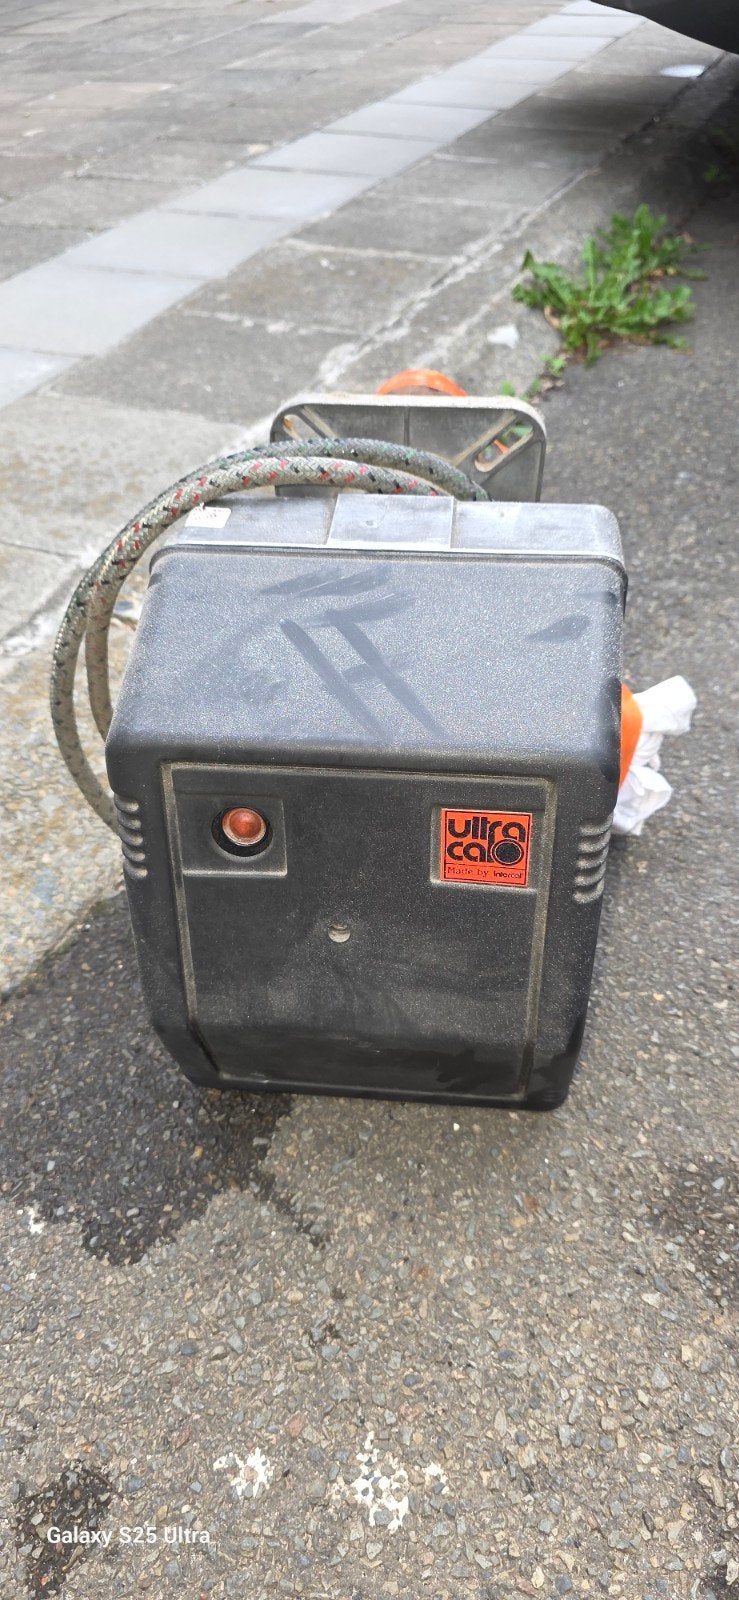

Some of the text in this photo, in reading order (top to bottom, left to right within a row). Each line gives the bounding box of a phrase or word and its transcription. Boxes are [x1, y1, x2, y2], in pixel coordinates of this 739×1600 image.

[448, 816, 526, 843] ultra
[447, 867, 473, 875] Made
[477, 868, 489, 878] by
